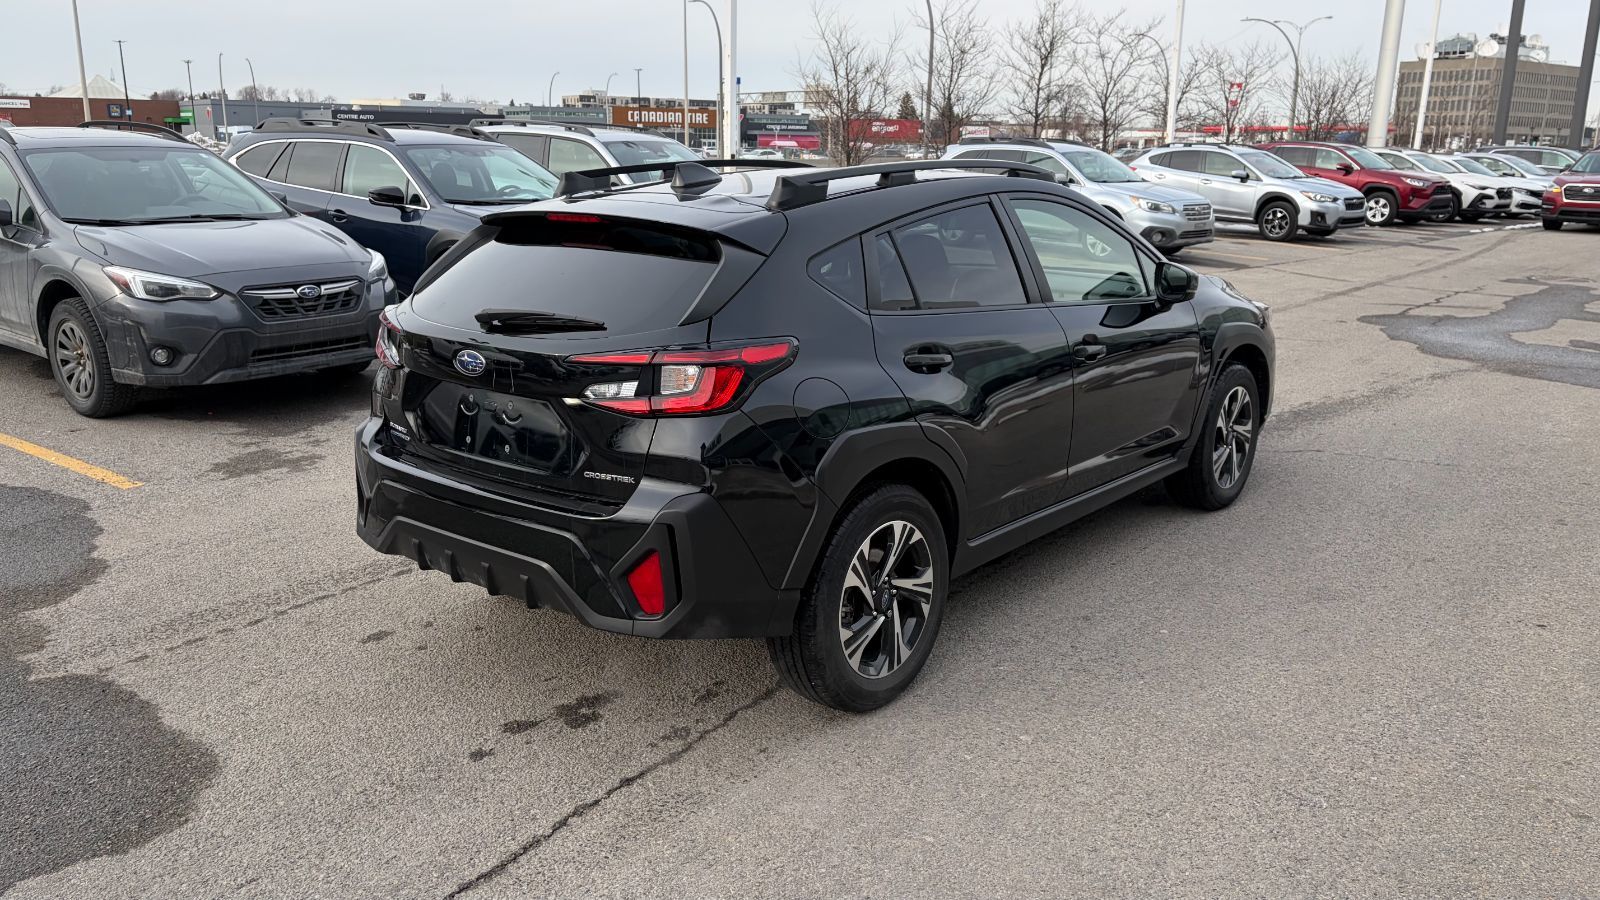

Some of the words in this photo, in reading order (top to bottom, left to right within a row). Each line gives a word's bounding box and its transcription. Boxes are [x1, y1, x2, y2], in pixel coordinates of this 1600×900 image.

[628, 111, 682, 124] CANADIAN
[687, 112, 709, 125] TIRE
[583, 471, 635, 484] CROSSTREK
